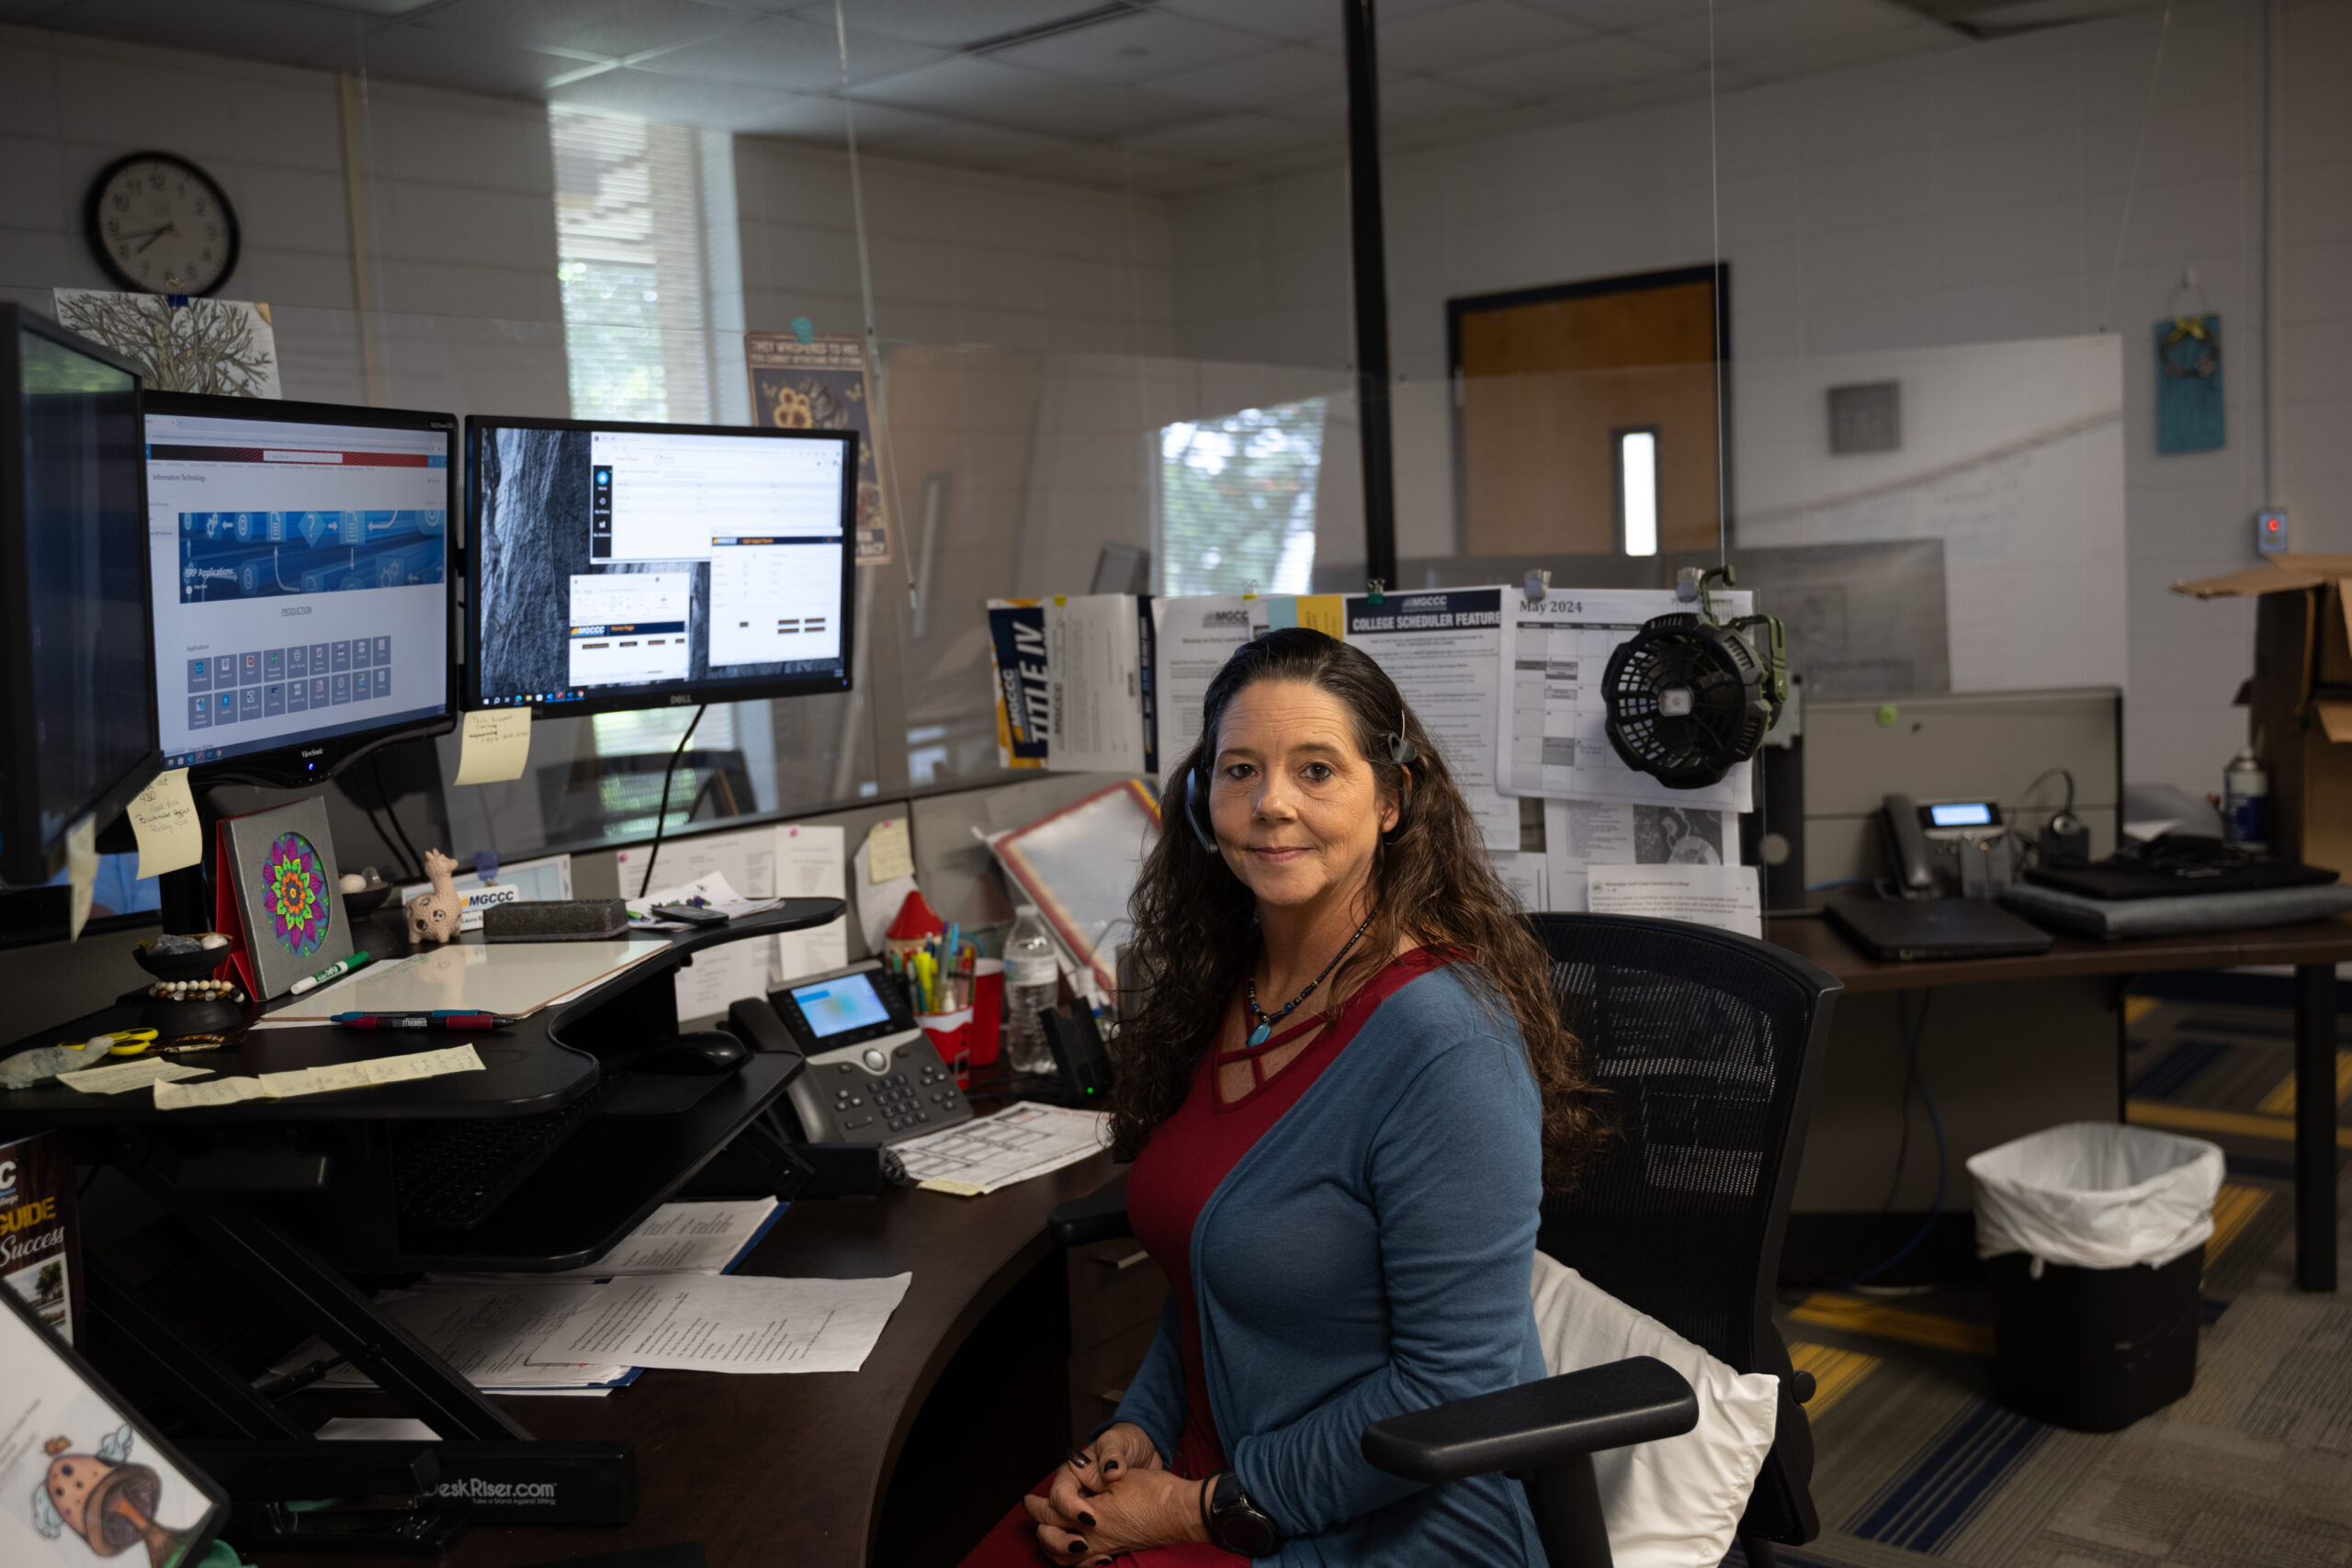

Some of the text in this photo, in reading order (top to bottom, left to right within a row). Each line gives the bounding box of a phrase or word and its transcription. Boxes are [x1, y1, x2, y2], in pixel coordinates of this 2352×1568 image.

[153, 473, 206, 483] Information Technology
[186, 566, 234, 579] ERP Applications
[1412, 596, 1448, 606] MGCCC
[281, 607, 312, 616] PRODUCTION
[1520, 601, 1583, 615] May 2024
[1352, 615, 1395, 631] COLLEGE
[1396, 613, 1453, 629] SCHEDULER
[578, 626, 605, 634] MGCCC
[1012, 621, 1049, 744] TITLE IV
[670, 694, 693, 705] DELL
[1002, 668, 1023, 728] MGCCC
[301, 747, 324, 758] ViewSonic
[469, 891, 514, 908] MGCCC
[0, 1225, 66, 1268] Success
